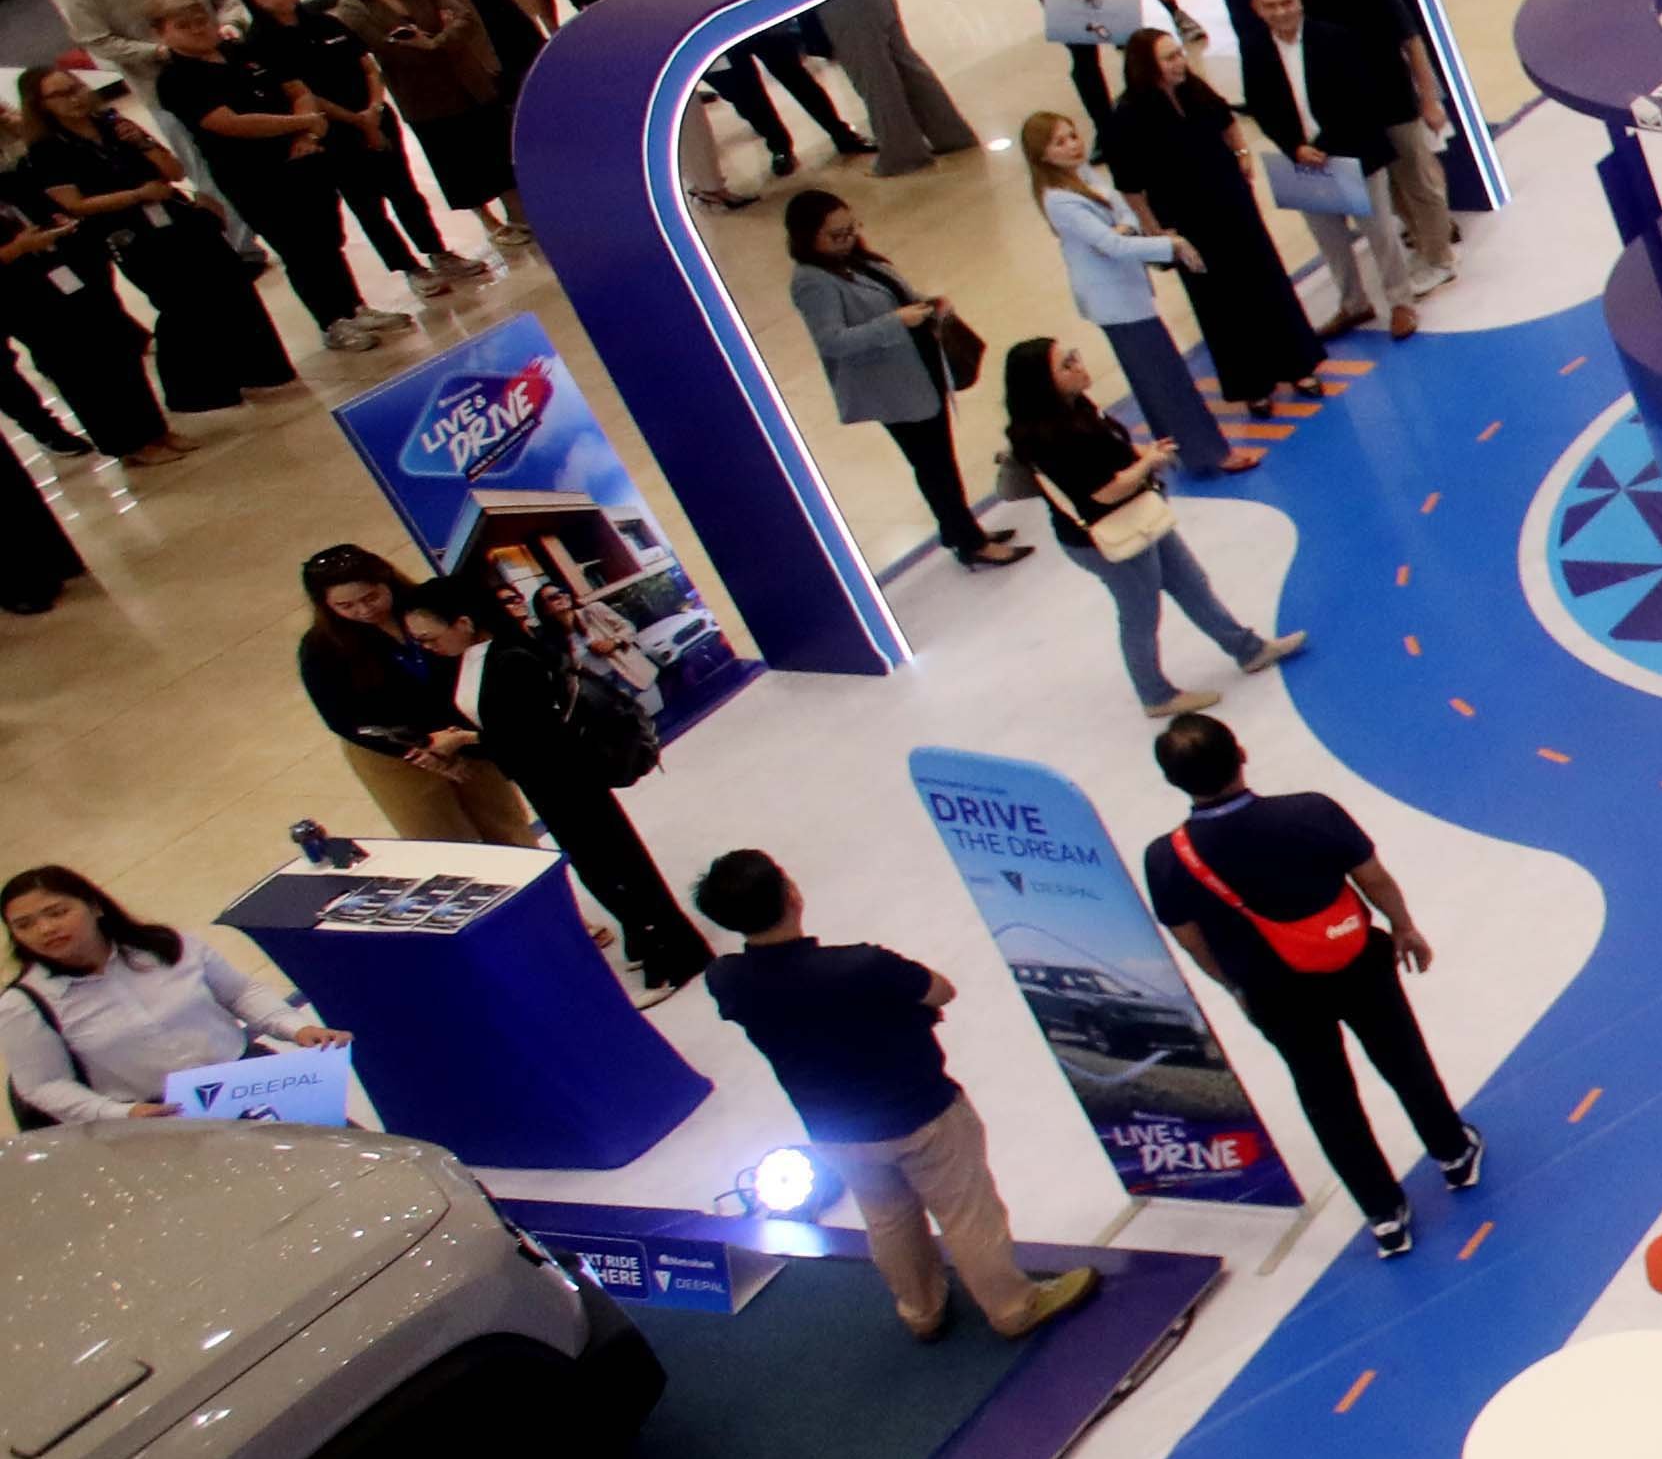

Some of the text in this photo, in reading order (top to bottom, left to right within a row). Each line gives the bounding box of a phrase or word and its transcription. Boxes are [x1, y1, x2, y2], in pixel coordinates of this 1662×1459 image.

[421, 399, 476, 453] LIVE
[449, 381, 534, 473] DRIVE
[930, 792, 1048, 835] DRIVE
[955, 828, 1101, 868] THE DREAM
[231, 1073, 326, 1100] DEEPAL
[1113, 1124, 1170, 1146] LIVE
[1139, 1138, 1241, 1173] DRIVE
[598, 1269, 643, 1286] HERE
[606, 1255, 639, 1270] RIDE
[675, 1278, 726, 1293] DEEPAL
